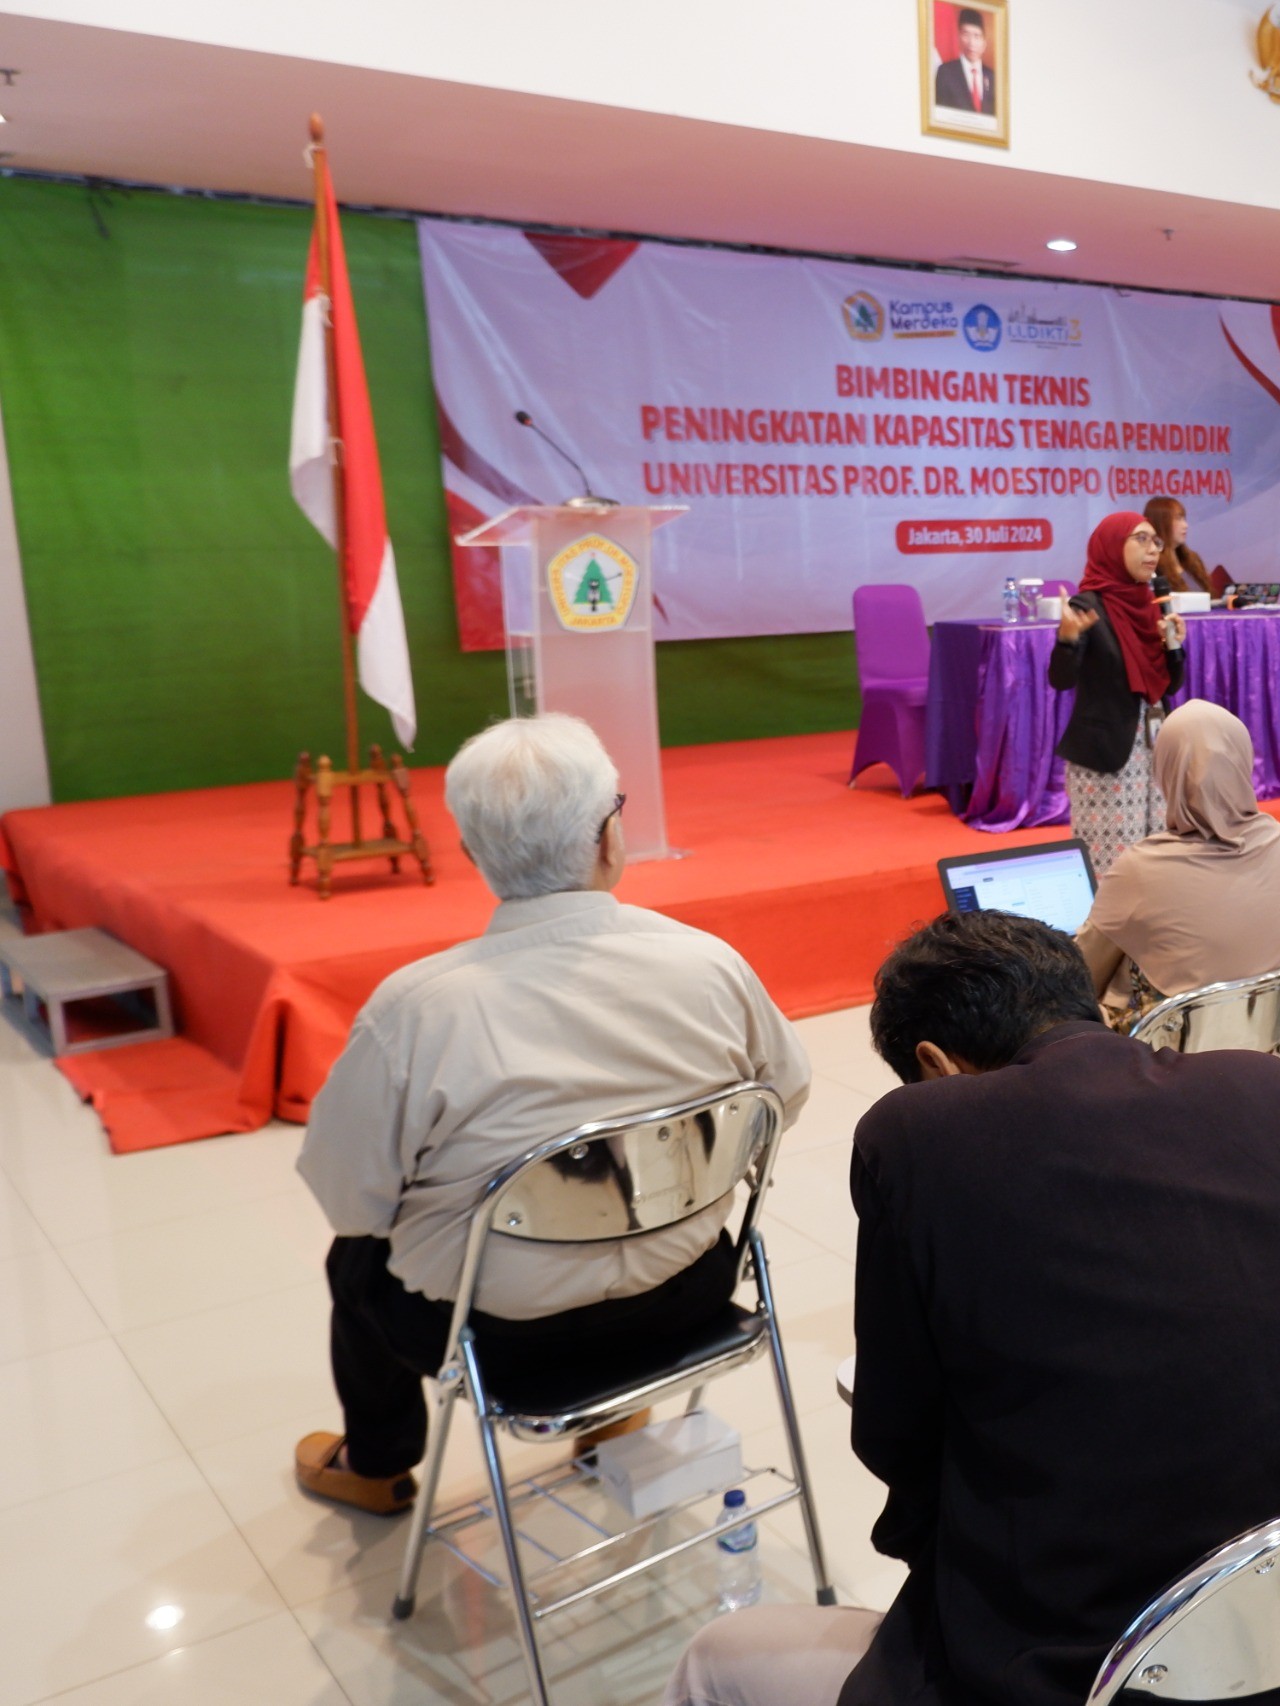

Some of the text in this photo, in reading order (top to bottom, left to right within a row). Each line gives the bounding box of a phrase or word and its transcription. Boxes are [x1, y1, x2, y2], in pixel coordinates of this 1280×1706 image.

[889, 300, 953, 320] Kampus
[890, 315, 958, 329] Merdeka
[836, 364, 1091, 408] BIMBINGAN TEKNIS
[641, 405, 1231, 454] PENINGKATAN KAPASITAS TENAGA PENDIDIK
[643, 462, 1233, 502] UNIVERSITAS PROF. DR. MOESTOPO (BERAGAMA)
[908, 525, 1042, 546] Jakarta, 30 Juli 2024
